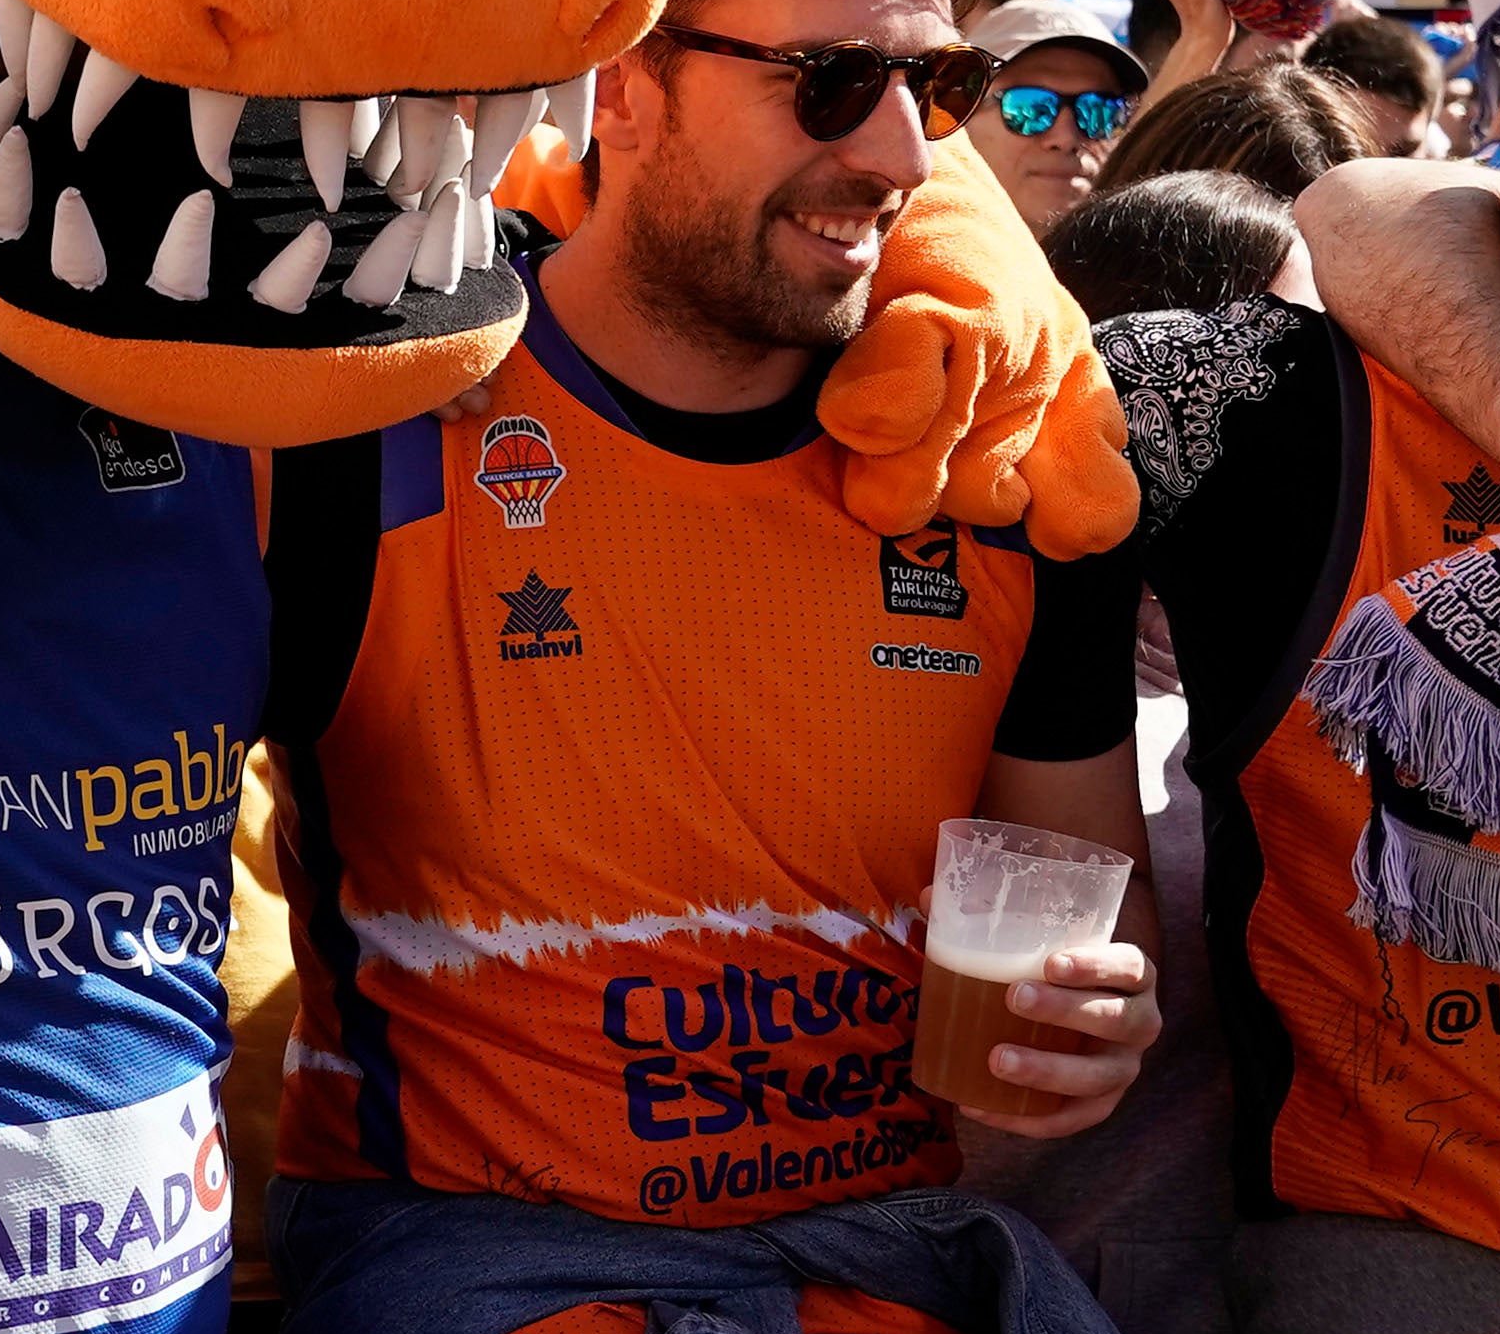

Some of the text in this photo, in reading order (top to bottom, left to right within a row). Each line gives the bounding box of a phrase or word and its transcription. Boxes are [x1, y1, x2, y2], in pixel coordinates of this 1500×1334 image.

[99, 431, 124, 458] liga
[105, 452, 175, 479] endesa
[483, 469, 559, 483] VALENCIA BASKET
[890, 580, 963, 601] AIRLINES
[890, 595, 959, 615] EuroLeague
[500, 634, 583, 661] luanvi
[869, 642, 982, 676] oneteam
